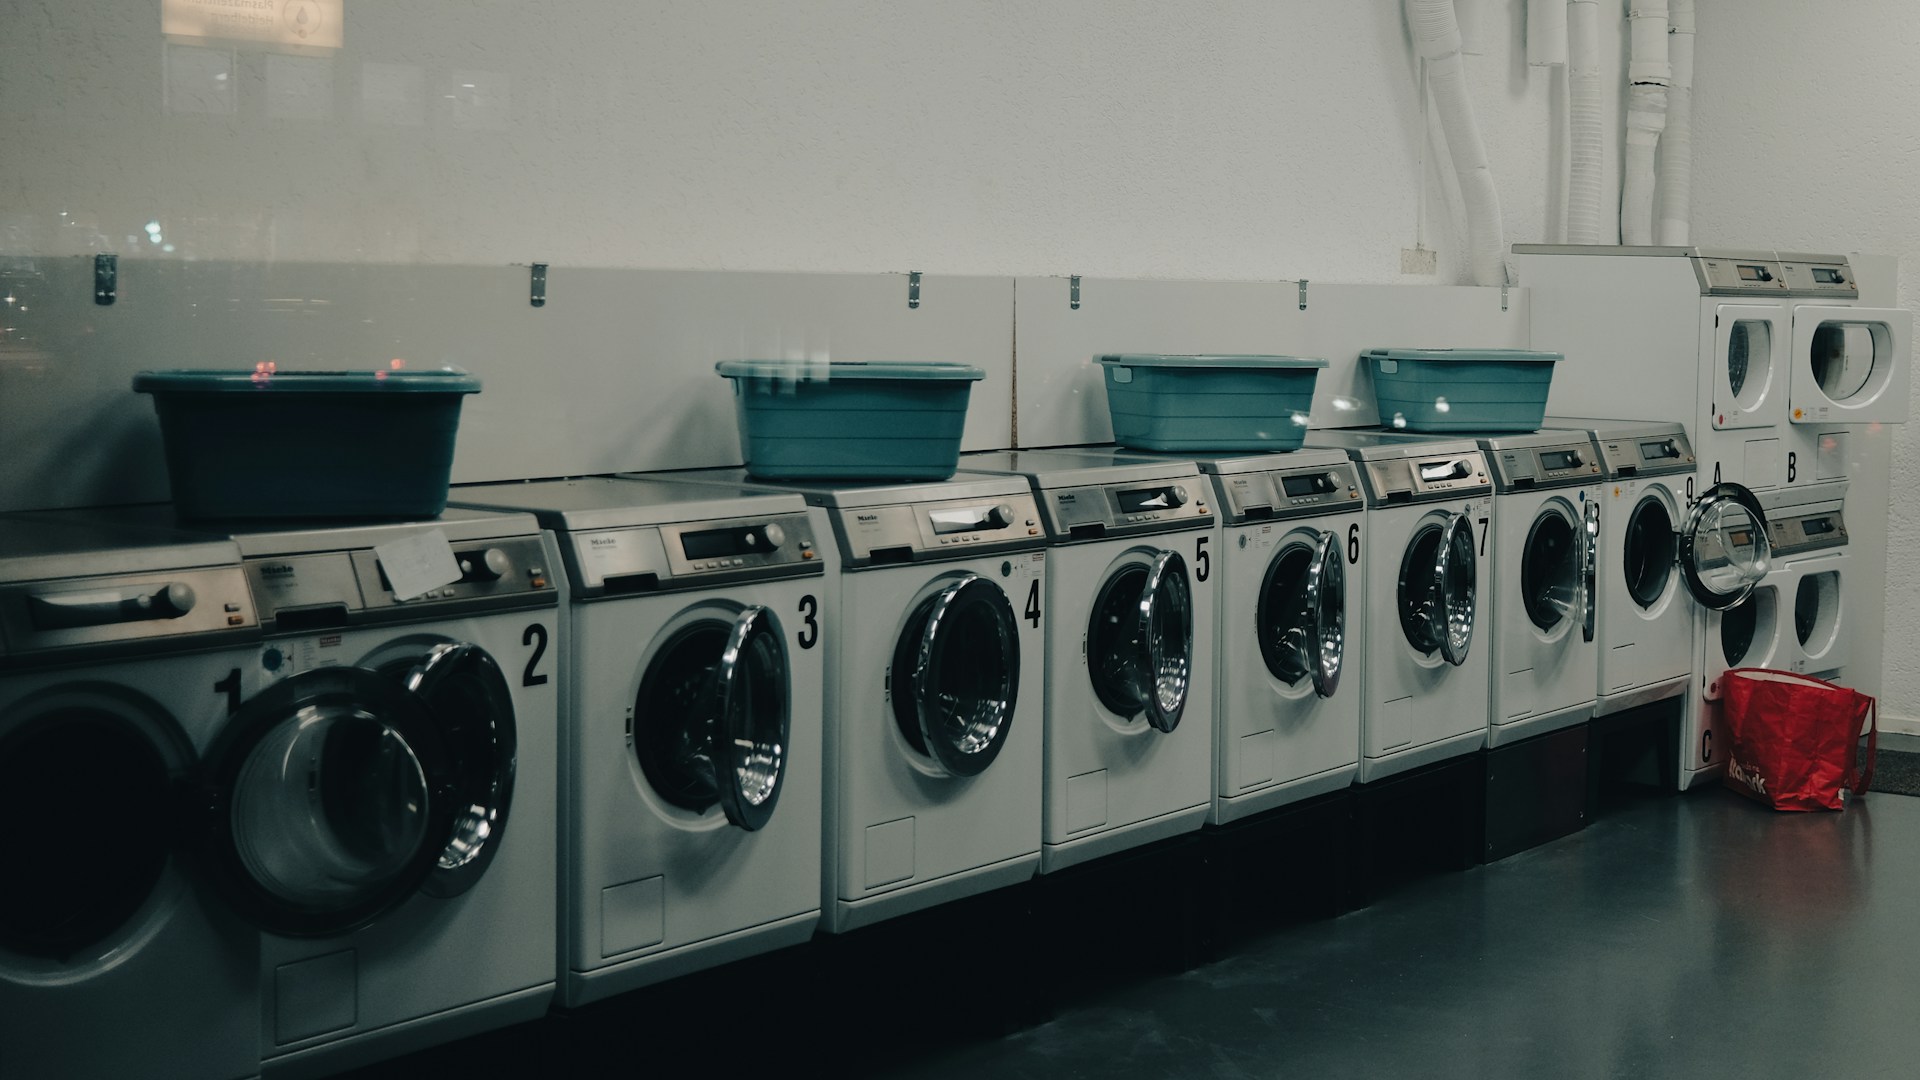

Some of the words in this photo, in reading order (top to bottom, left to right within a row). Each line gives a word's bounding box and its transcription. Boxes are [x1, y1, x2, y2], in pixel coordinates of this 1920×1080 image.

[1713, 461, 1721, 484] A
[1788, 452, 1796, 482] B
[1686, 476, 1694, 509] 9
[590, 538, 616, 546] Miele
[1348, 523, 1359, 564] 6
[1479, 518, 1488, 556] 7
[260, 565, 294, 575] Miele
[1196, 536, 1209, 582] 5
[798, 594, 818, 650] 3
[1025, 579, 1040, 629] 4
[522, 623, 548, 687] 2
[214, 668, 242, 717] 1
[1702, 729, 1712, 762] C
